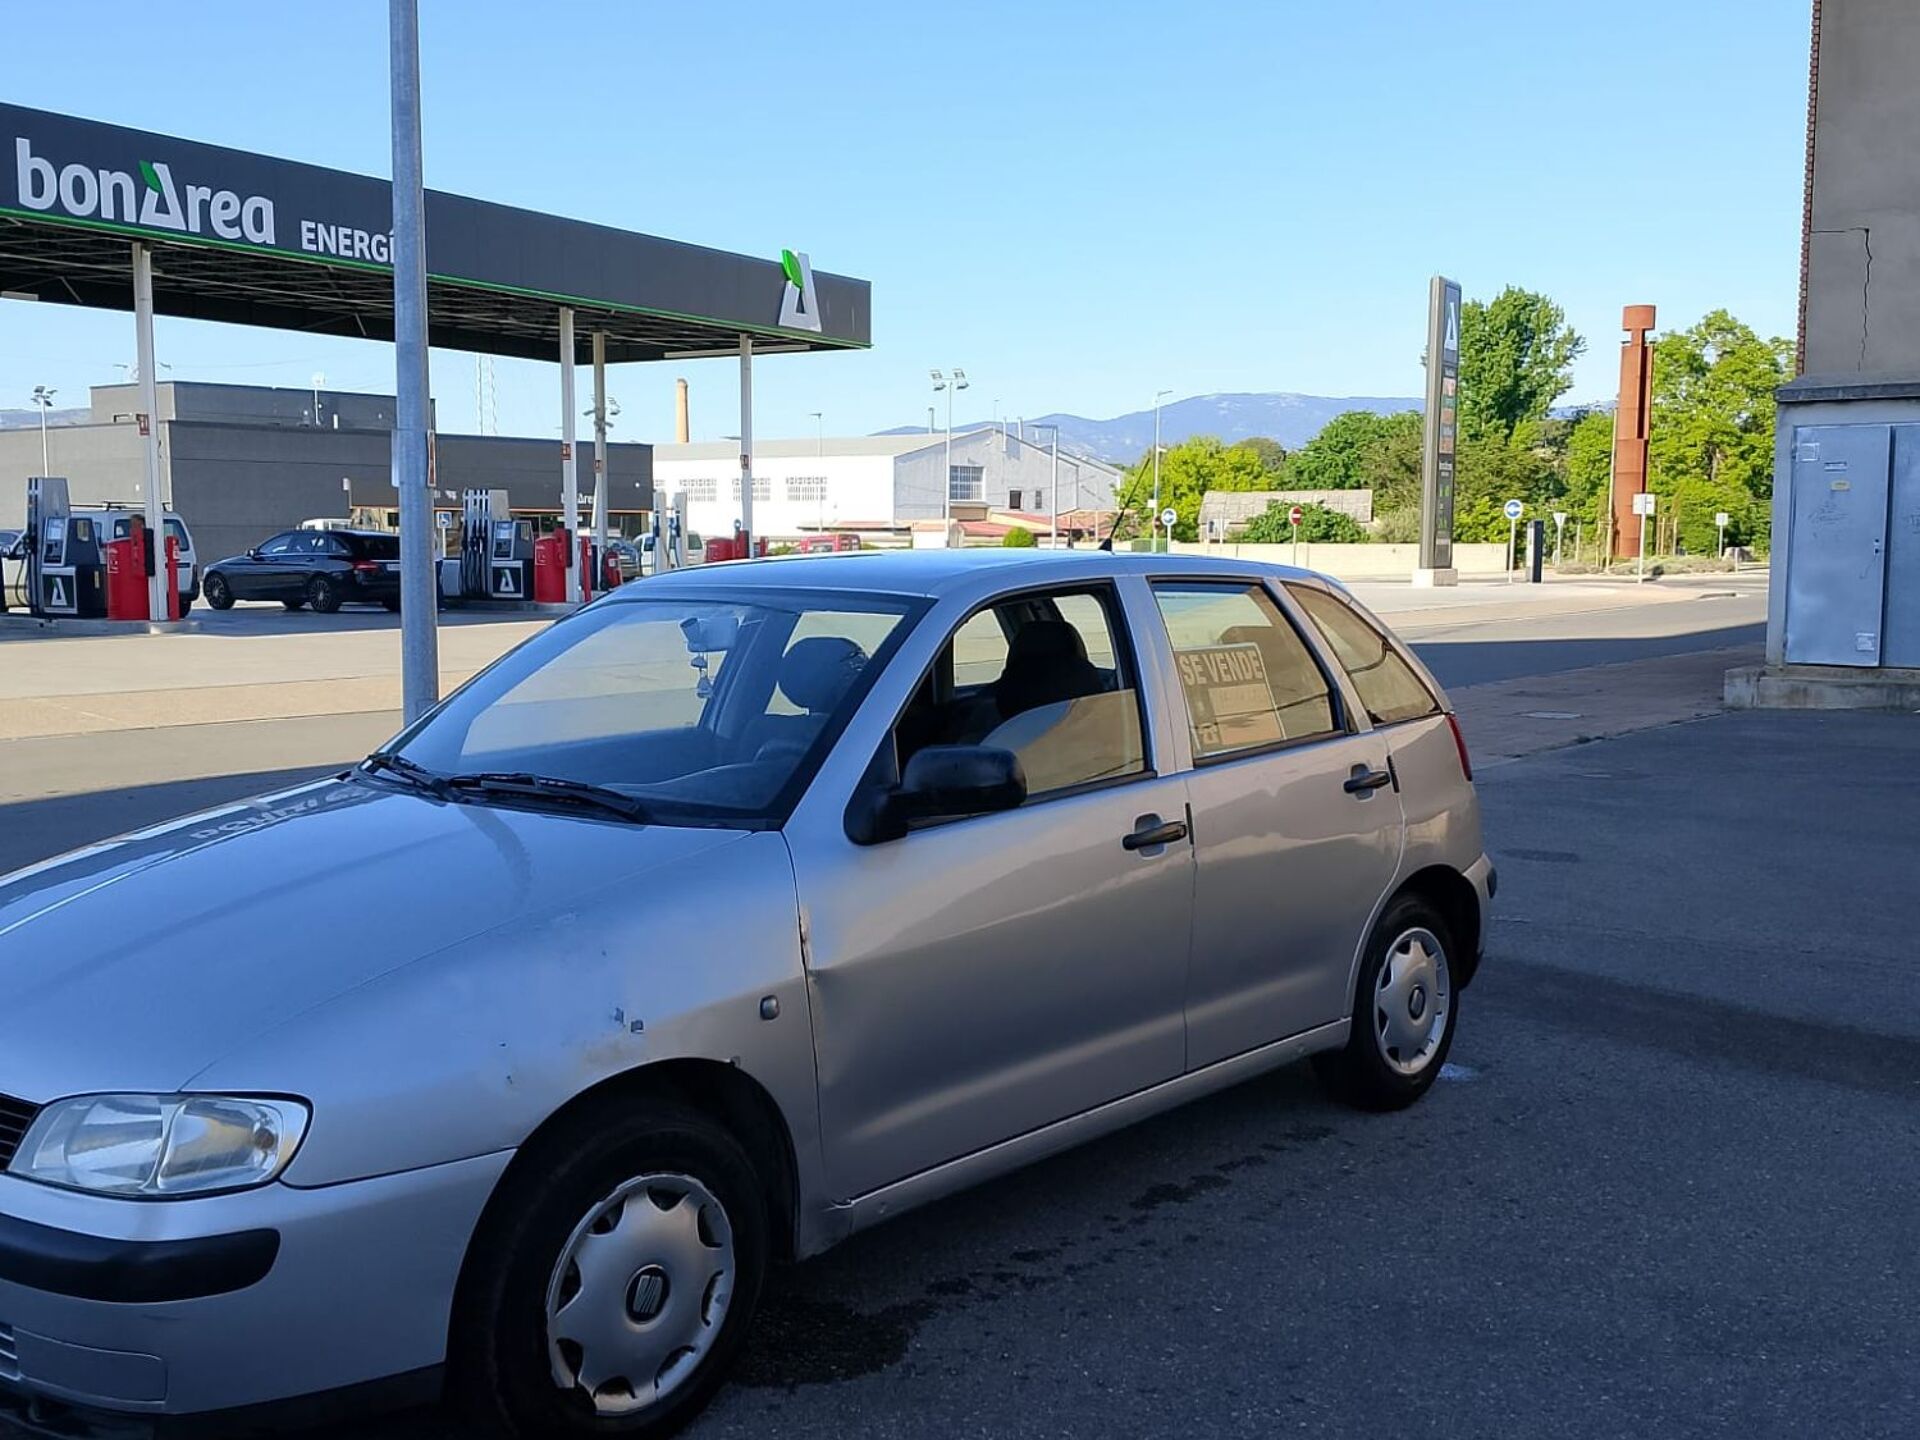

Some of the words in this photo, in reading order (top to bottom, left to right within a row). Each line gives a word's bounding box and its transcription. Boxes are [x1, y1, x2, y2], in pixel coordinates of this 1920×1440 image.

[16, 137, 276, 245] bonArea
[1179, 654, 1208, 686] SE
[1201, 650, 1263, 683] VENDE
